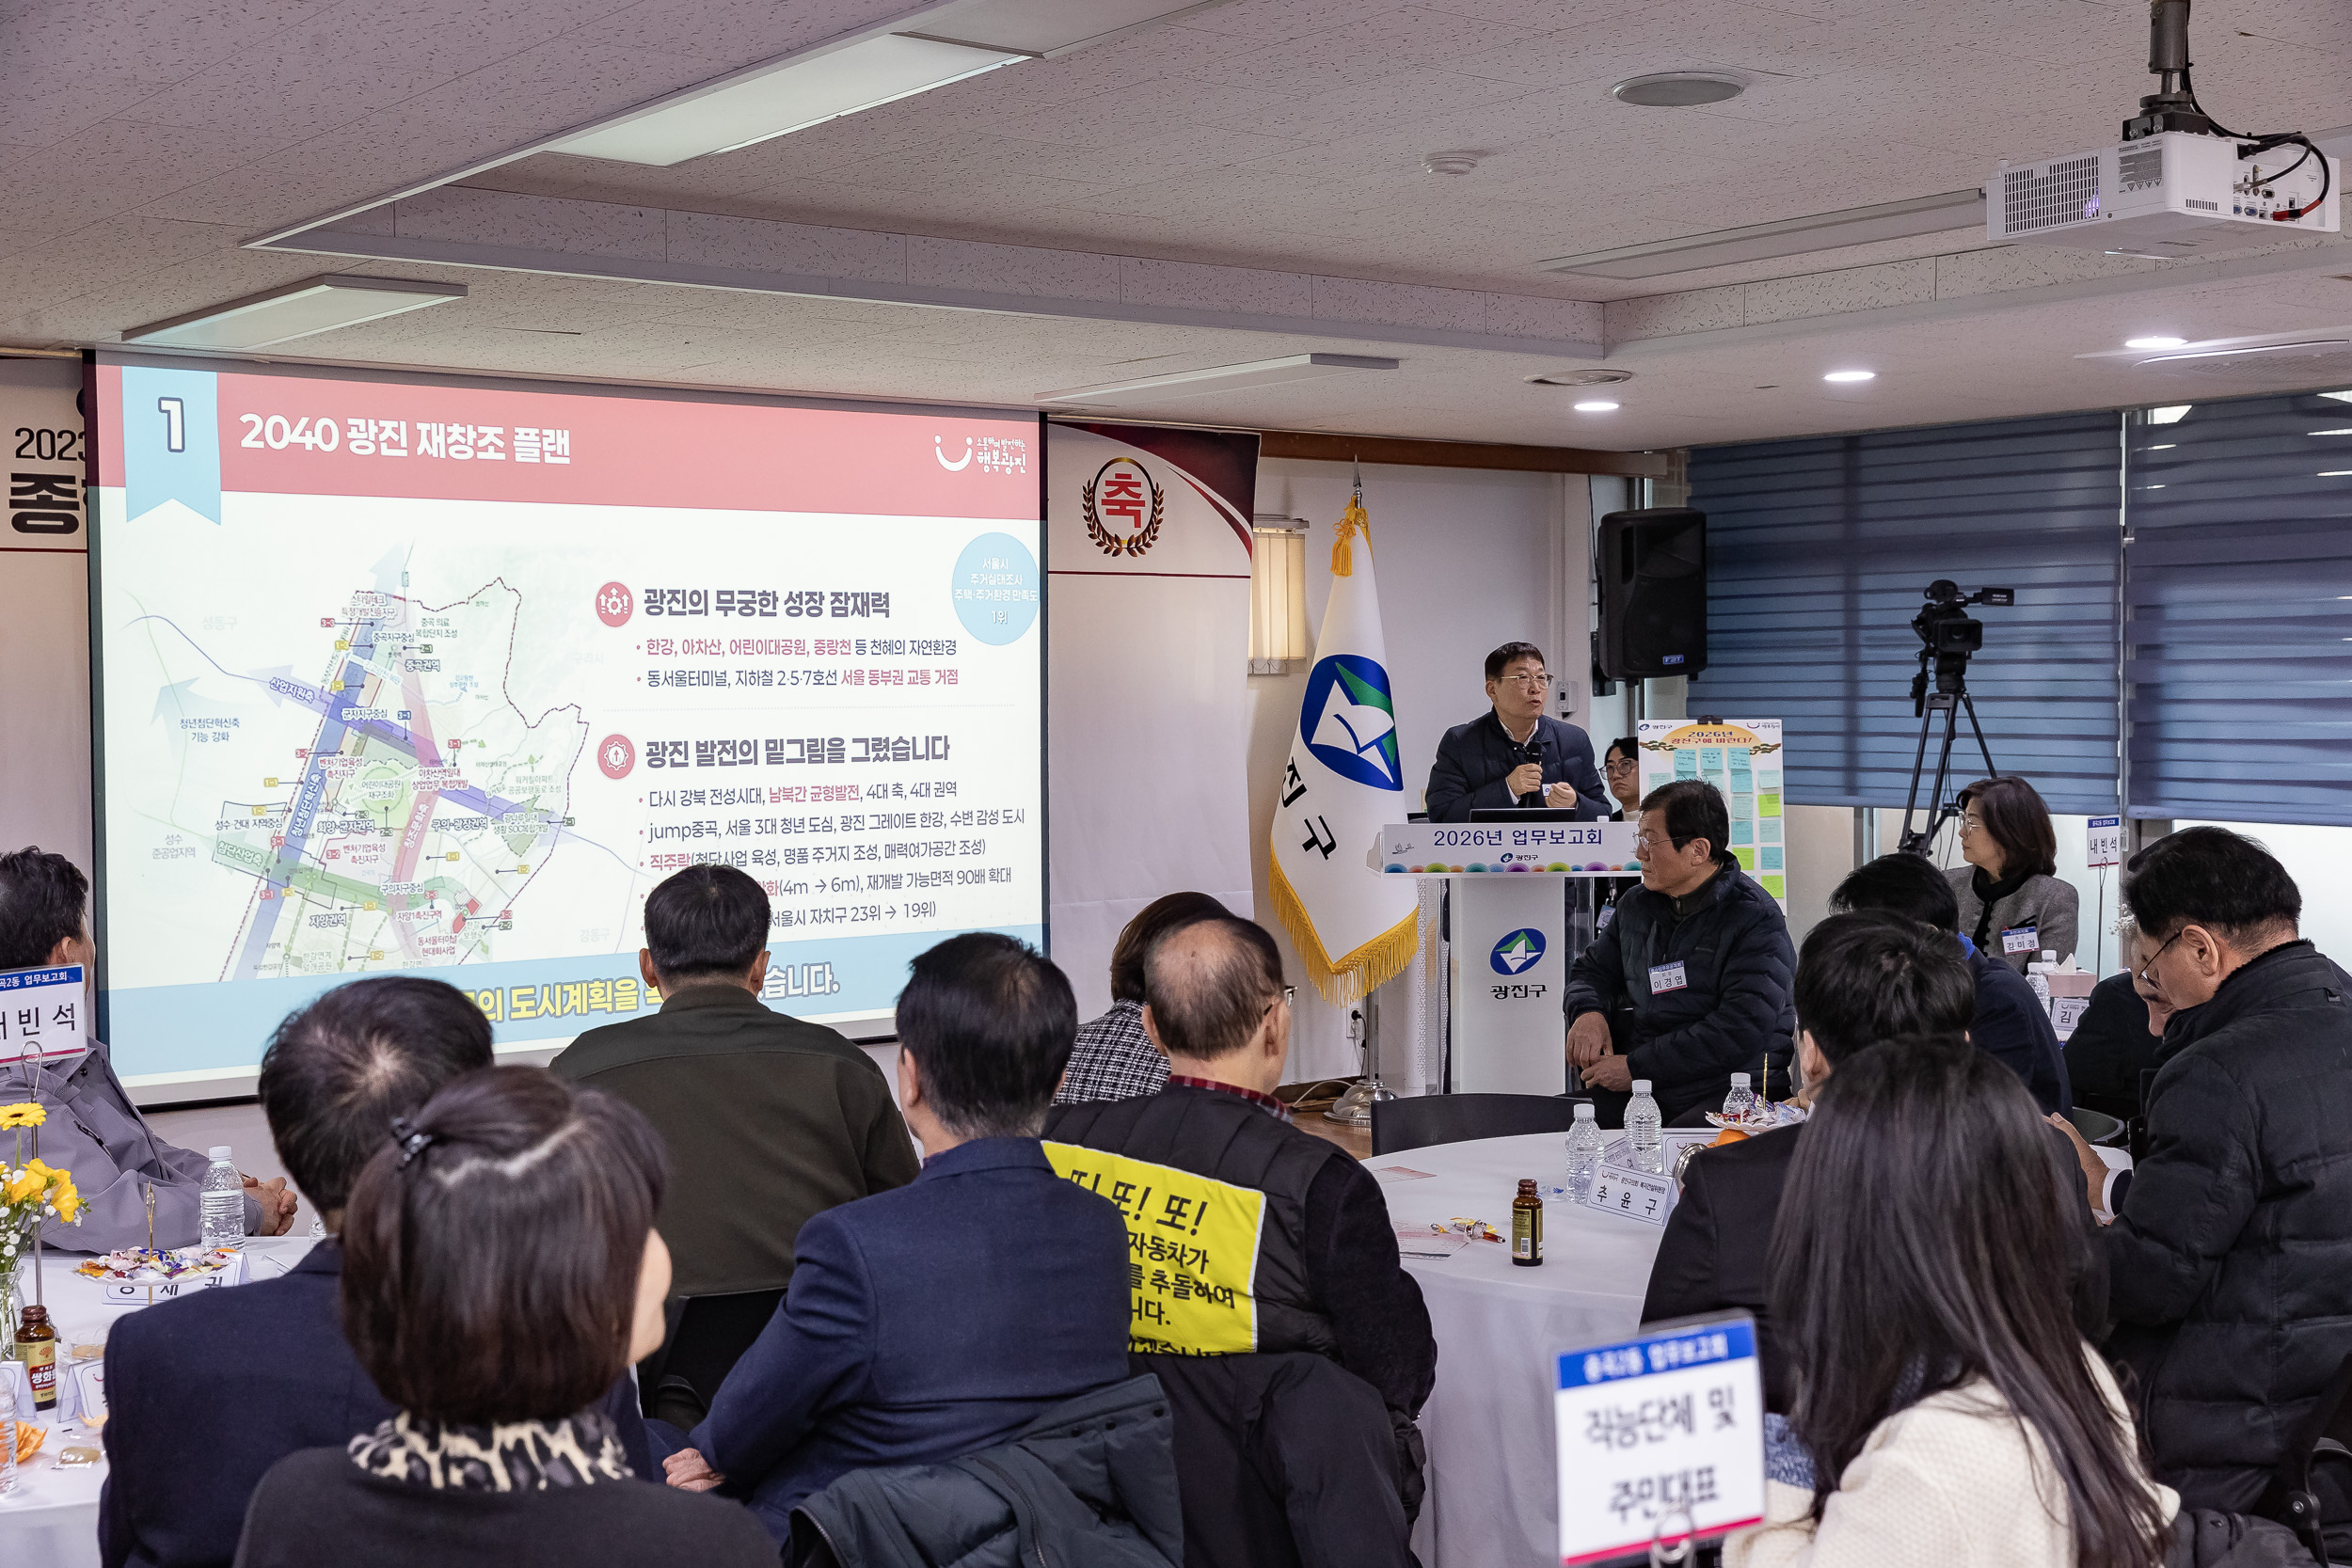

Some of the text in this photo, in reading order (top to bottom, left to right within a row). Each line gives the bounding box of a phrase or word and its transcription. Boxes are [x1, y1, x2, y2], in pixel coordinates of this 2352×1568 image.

[158, 397, 185, 453] 1
[239, 413, 571, 465] 2040 광진 재창조 플랜
[977, 450, 1026, 475] 행복광진
[9, 472, 87, 534] 종
[1101, 472, 1146, 529] 축
[982, 557, 1009, 570] 서울시
[970, 573, 1024, 587] 주거실태조사
[1012, 588, 1039, 602] 만족도
[644, 589, 891, 620] 광진의 무궁한 성장 잠재력
[992, 610, 1009, 626] 1위
[373, 633, 415, 642] 중곡지구중심
[647, 638, 958, 658] 한강, 아차산, 어린이대공원, 중랑천 등 천혜의 자연환경
[405, 659, 440, 672] 중곡권역
[647, 669, 959, 689] 동서울터미널, 지하철 2·5·7호선 서울 동부권 교통 거점
[269, 677, 315, 704] 산업지원축
[179, 717, 240, 729] 청년첨단혁신축
[342, 708, 388, 720] 군자지구중심
[191, 732, 230, 743] 기능 강화
[645, 735, 950, 768] 광진 발전의 밑그림을 그렸습니다
[319, 757, 363, 768] 벤처기업육성
[327, 769, 356, 779] 촉진지구
[419, 768, 461, 778] 아차산역일대
[412, 780, 469, 790] 상업업무 복합개발
[649, 781, 958, 808] 다시 강북 전성시대, 남북간 균형발전, 4대 축, 4대 권역
[252, 817, 283, 829] 지역중심
[648, 808, 1025, 844] jump중곡, 서울 3대 청년 도심, 광진 그레이트 한강, 수변 감성 도시
[165, 833, 183, 845] 성수
[1434, 829, 1603, 847] 2026년 업무보고회
[151, 847, 196, 859] 준공업지역
[217, 841, 263, 867] 첨단산업축
[343, 844, 386, 854] 벤처기업육성
[751, 848, 781, 868] 육성,
[784, 847, 808, 865] 명품
[812, 846, 850, 864] 주거지
[853, 845, 881, 863] 조성,
[884, 841, 956, 861] 매력여가공간
[959, 839, 987, 857] 조성)
[866, 873, 903, 892] 재개발
[906, 871, 954, 890] 가능면적
[957, 868, 986, 886] 90배
[989, 866, 1012, 884] 확대
[381, 883, 423, 895] 구의지구중심
[310, 914, 346, 927] 자양권역
[810, 907, 848, 926] 자치구
[850, 905, 881, 923] 23위
[904, 901, 937, 920] 19위)
[418, 935, 457, 946] 동서울터미널
[421, 946, 456, 957] 현대화사업
[24, 971, 68, 986] 업무보고회
[757, 961, 840, 1000] 습니다.
[510, 977, 640, 1020] 도시계획을
[1489, 985, 1549, 1000] 광진구
[1155, 1194, 1209, 1237] 또!
[1128, 1231, 1210, 1275] 자동차가
[1150, 1270, 1235, 1309] 추돌하여
[1584, 1393, 1695, 1453] 직능단체
[1609, 1465, 1721, 1525] 주민대표
